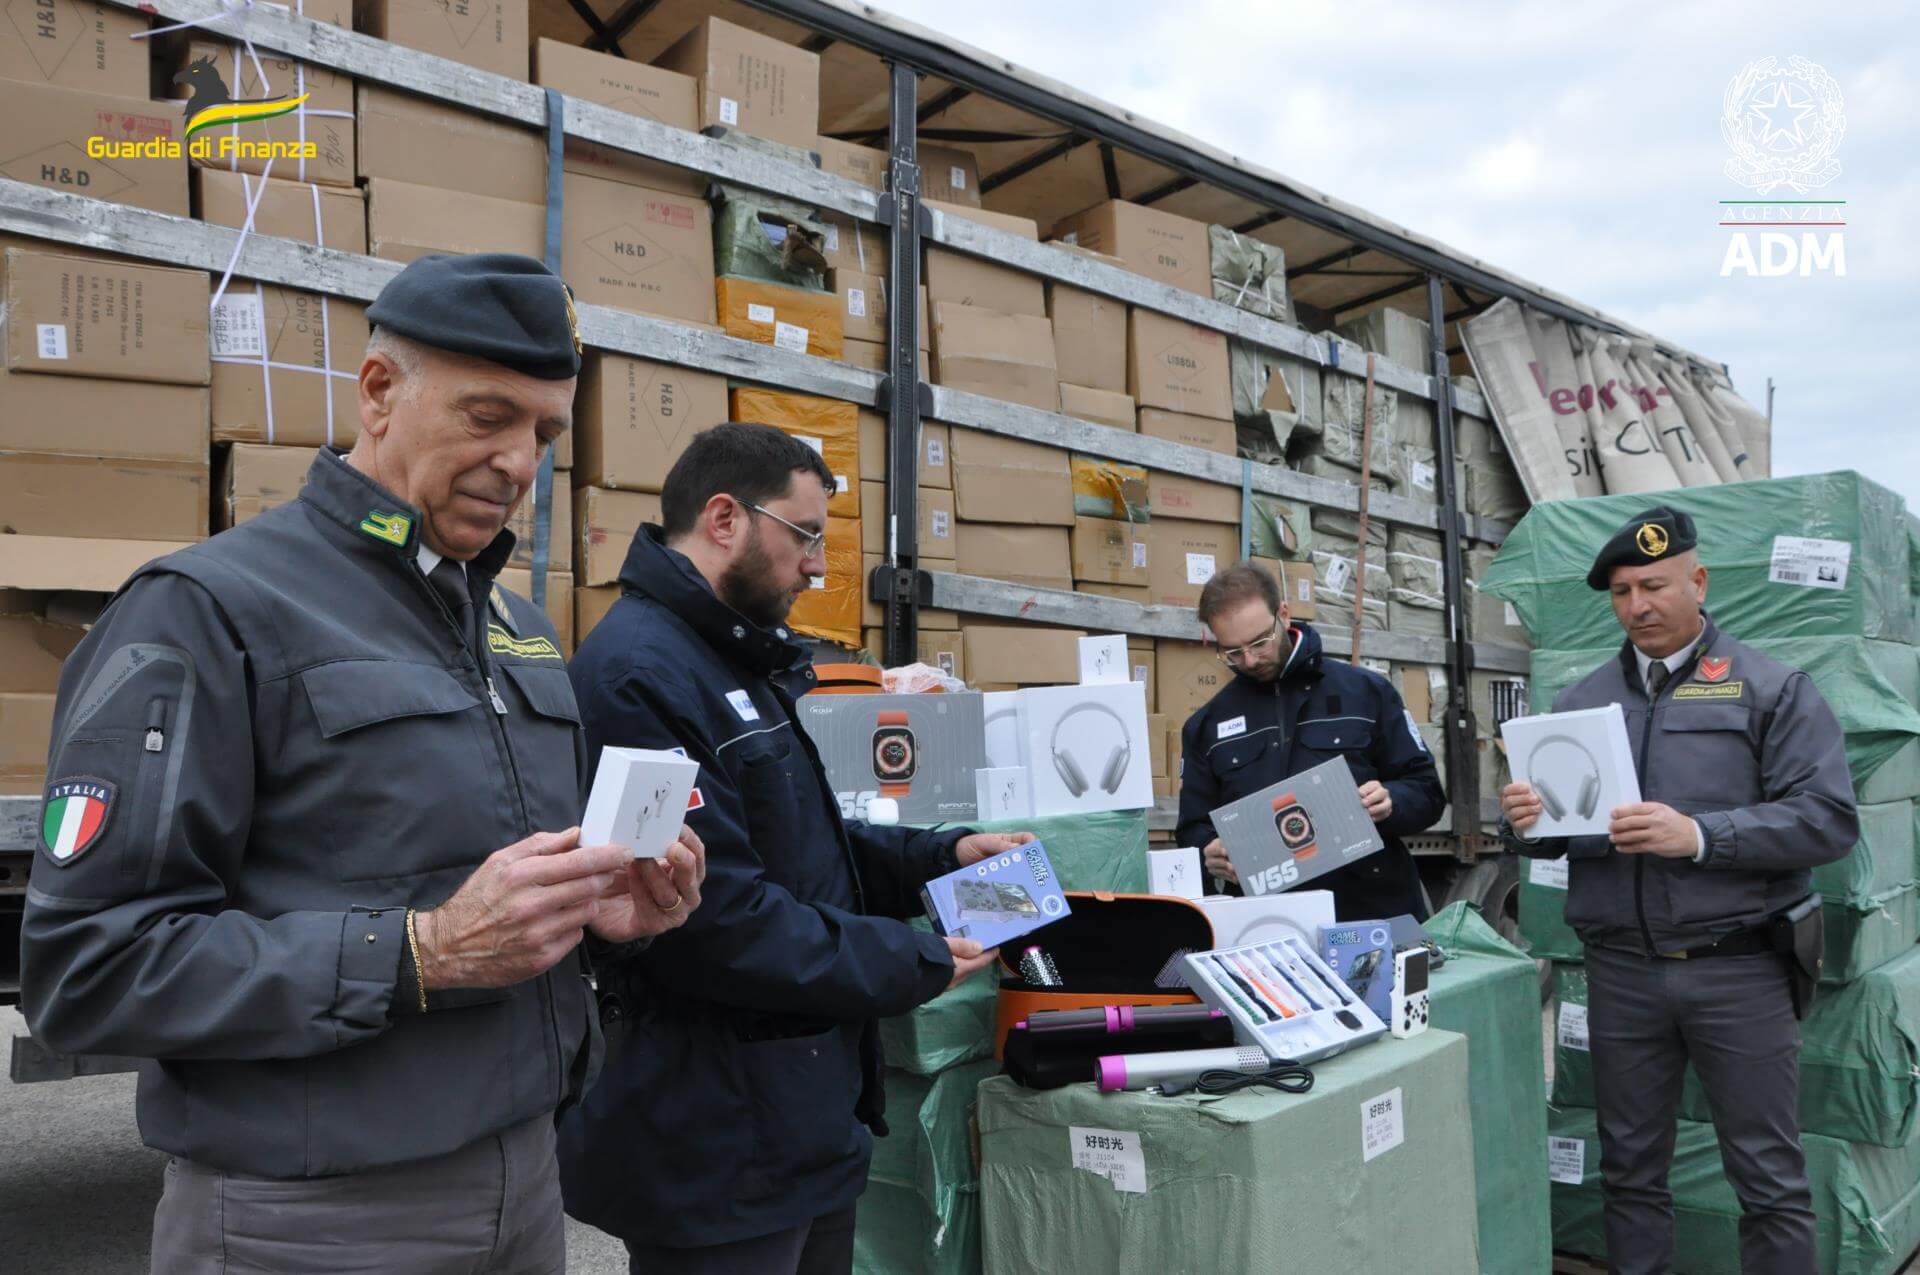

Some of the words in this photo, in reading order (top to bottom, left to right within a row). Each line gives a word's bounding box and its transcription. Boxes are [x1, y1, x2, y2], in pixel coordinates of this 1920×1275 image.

[96, 39, 105, 70] MADE
[614, 241, 646, 257] H&D
[599, 276, 623, 286] MADE
[1167, 354, 1198, 369] LISBOA
[627, 362, 636, 388] MADE
[661, 383, 674, 417] H&D
[55, 784, 105, 799] ITALIA
[1024, 848, 1046, 887] CONSOLE
[1028, 846, 1049, 879] GAME
[1329, 930, 1358, 941] GAME
[1369, 1098, 1393, 1119] 好时光
[1085, 1135, 1124, 1151] 好时光
